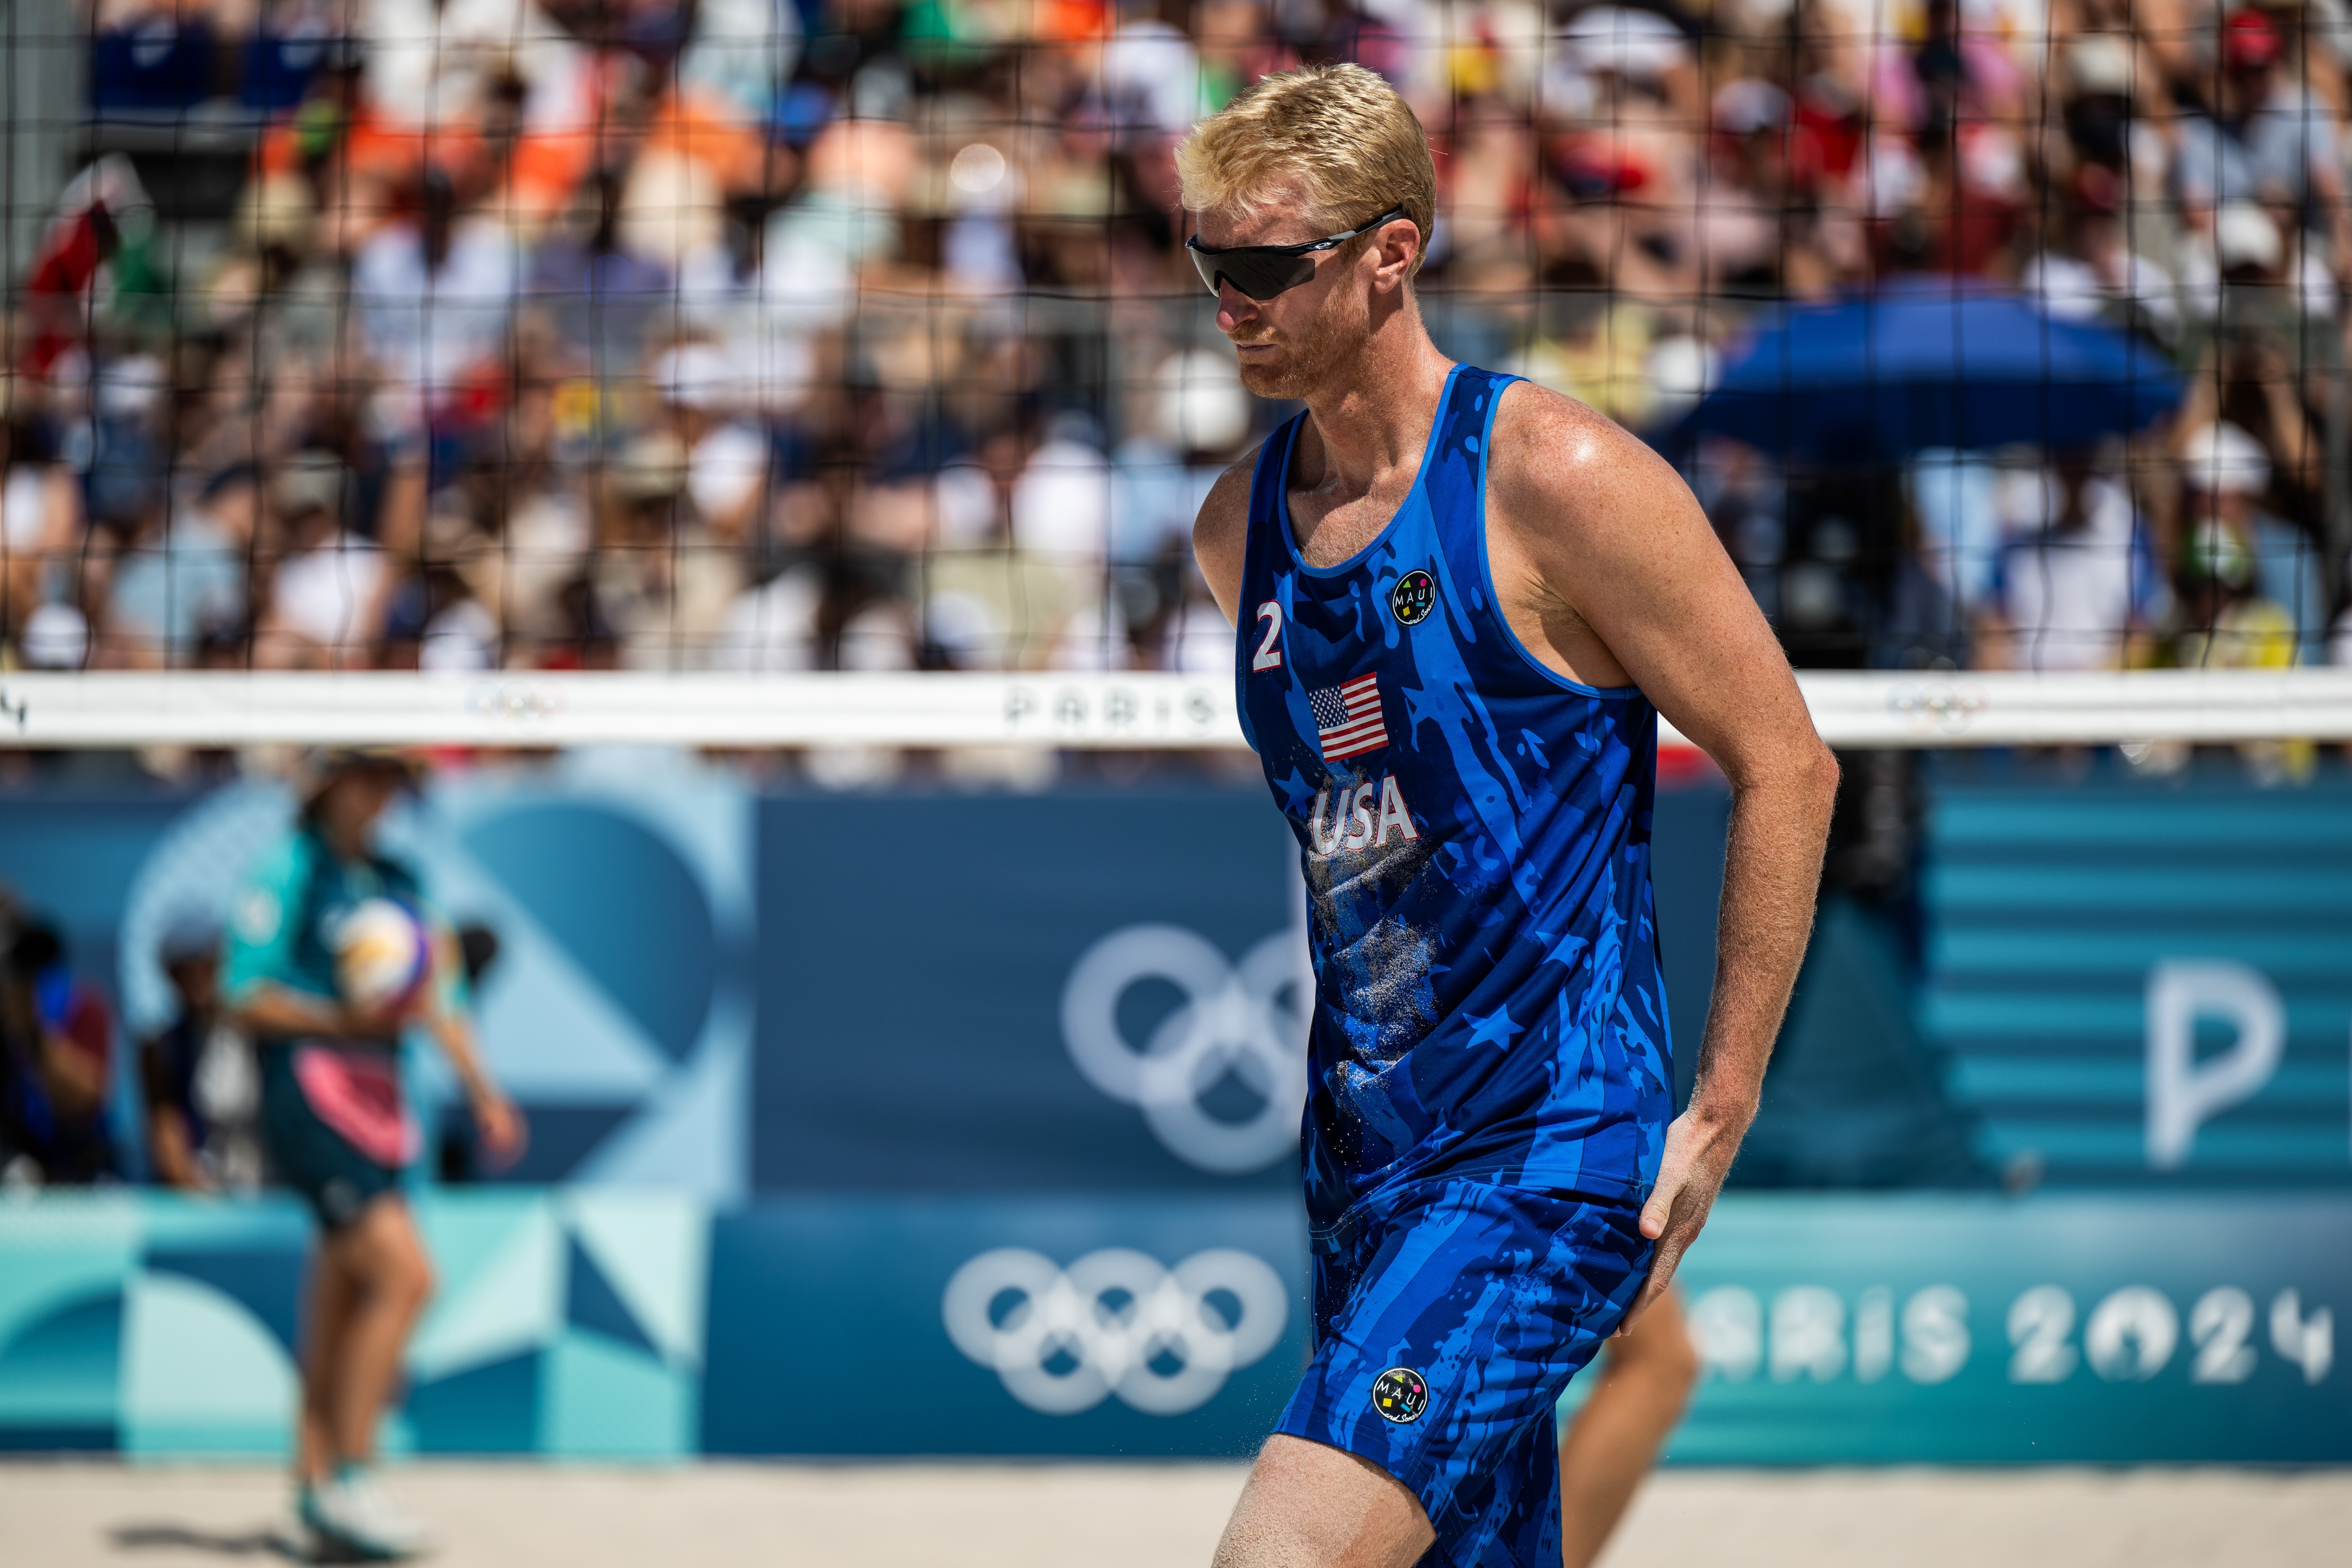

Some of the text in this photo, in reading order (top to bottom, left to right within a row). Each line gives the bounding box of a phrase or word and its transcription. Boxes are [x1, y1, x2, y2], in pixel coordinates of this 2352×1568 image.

[1395, 586, 1433, 607] MAUI
[1408, 614, 1420, 624] and
[1252, 599, 1283, 673] 2
[1002, 686, 1218, 736] PARIS
[1310, 773, 1421, 856] USA
[2146, 958, 2352, 1170] P
[1686, 1284, 2334, 1384] ARIS 2024
[1376, 1380, 1424, 1410] MAUI
[1383, 1413, 1400, 1421] and
